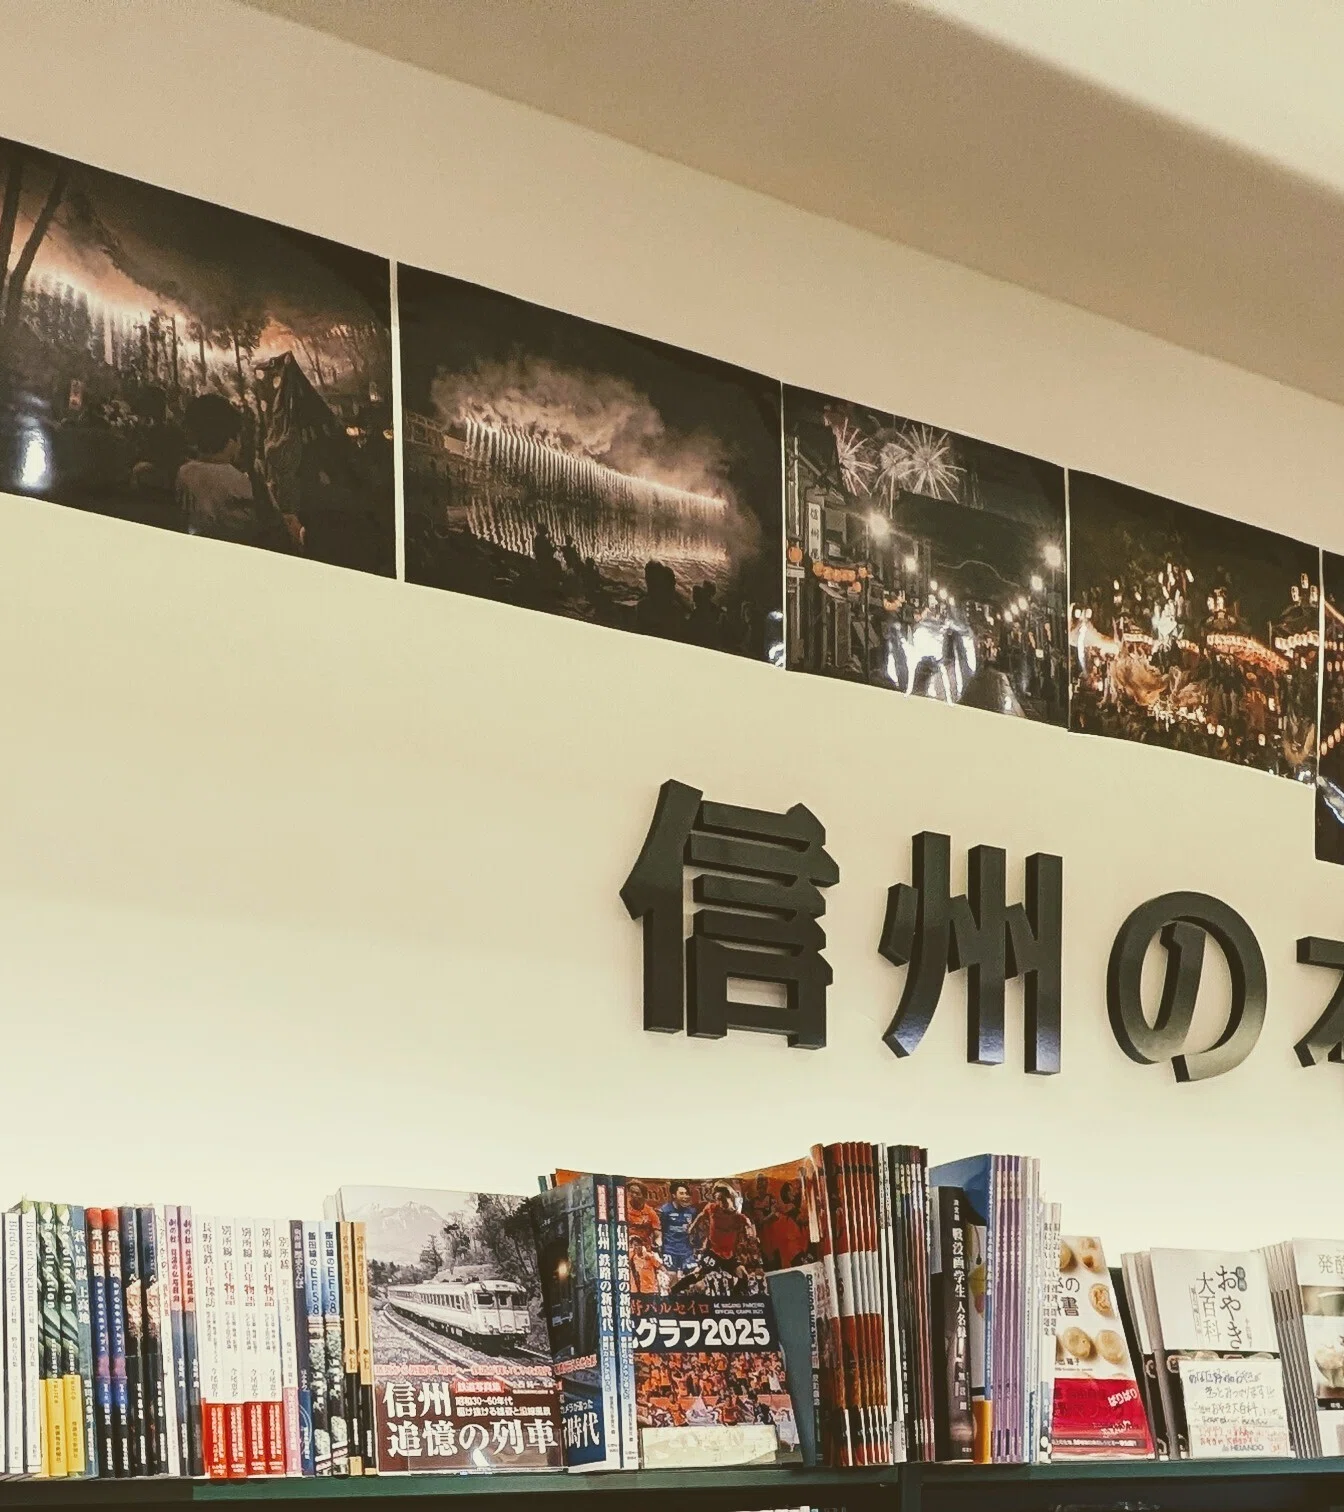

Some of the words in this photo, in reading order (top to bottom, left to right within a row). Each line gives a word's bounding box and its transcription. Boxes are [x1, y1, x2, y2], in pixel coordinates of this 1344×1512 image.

[597, 1223, 609, 1252] 信州
[952, 1228, 966, 1298] 戦没画学生
[308, 1232, 320, 1315] 飯田線のEF58
[599, 1254, 614, 1332] 鉄路の新時代
[1196, 1271, 1222, 1343] 大百科
[1216, 1264, 1244, 1350] おやき
[955, 1300, 967, 1339] 人名録
[383, 1381, 456, 1418] 信州
[386, 1419, 559, 1458] 追憶の列車
